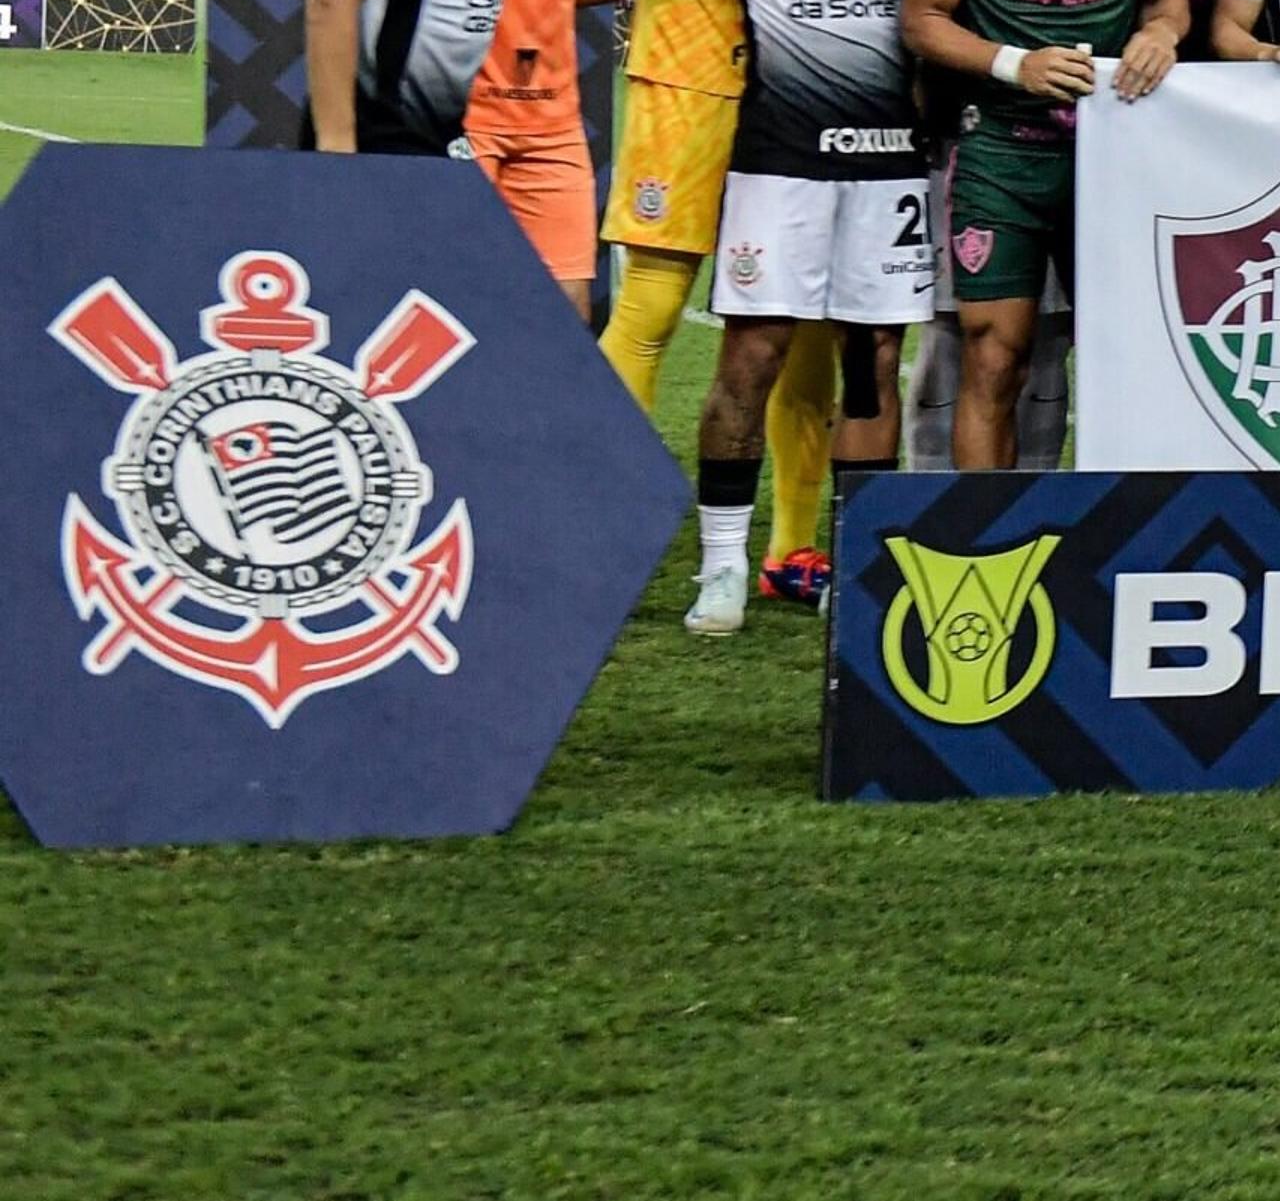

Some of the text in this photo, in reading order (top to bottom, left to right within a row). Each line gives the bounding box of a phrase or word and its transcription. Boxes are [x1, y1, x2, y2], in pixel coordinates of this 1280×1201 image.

[818, 127, 916, 153] FOXLUX
[890, 192, 932, 247] 2
[145, 371, 344, 487] CORINTHIANS
[342, 409, 393, 562] PAULISTA
[233, 561, 319, 591] 1910
